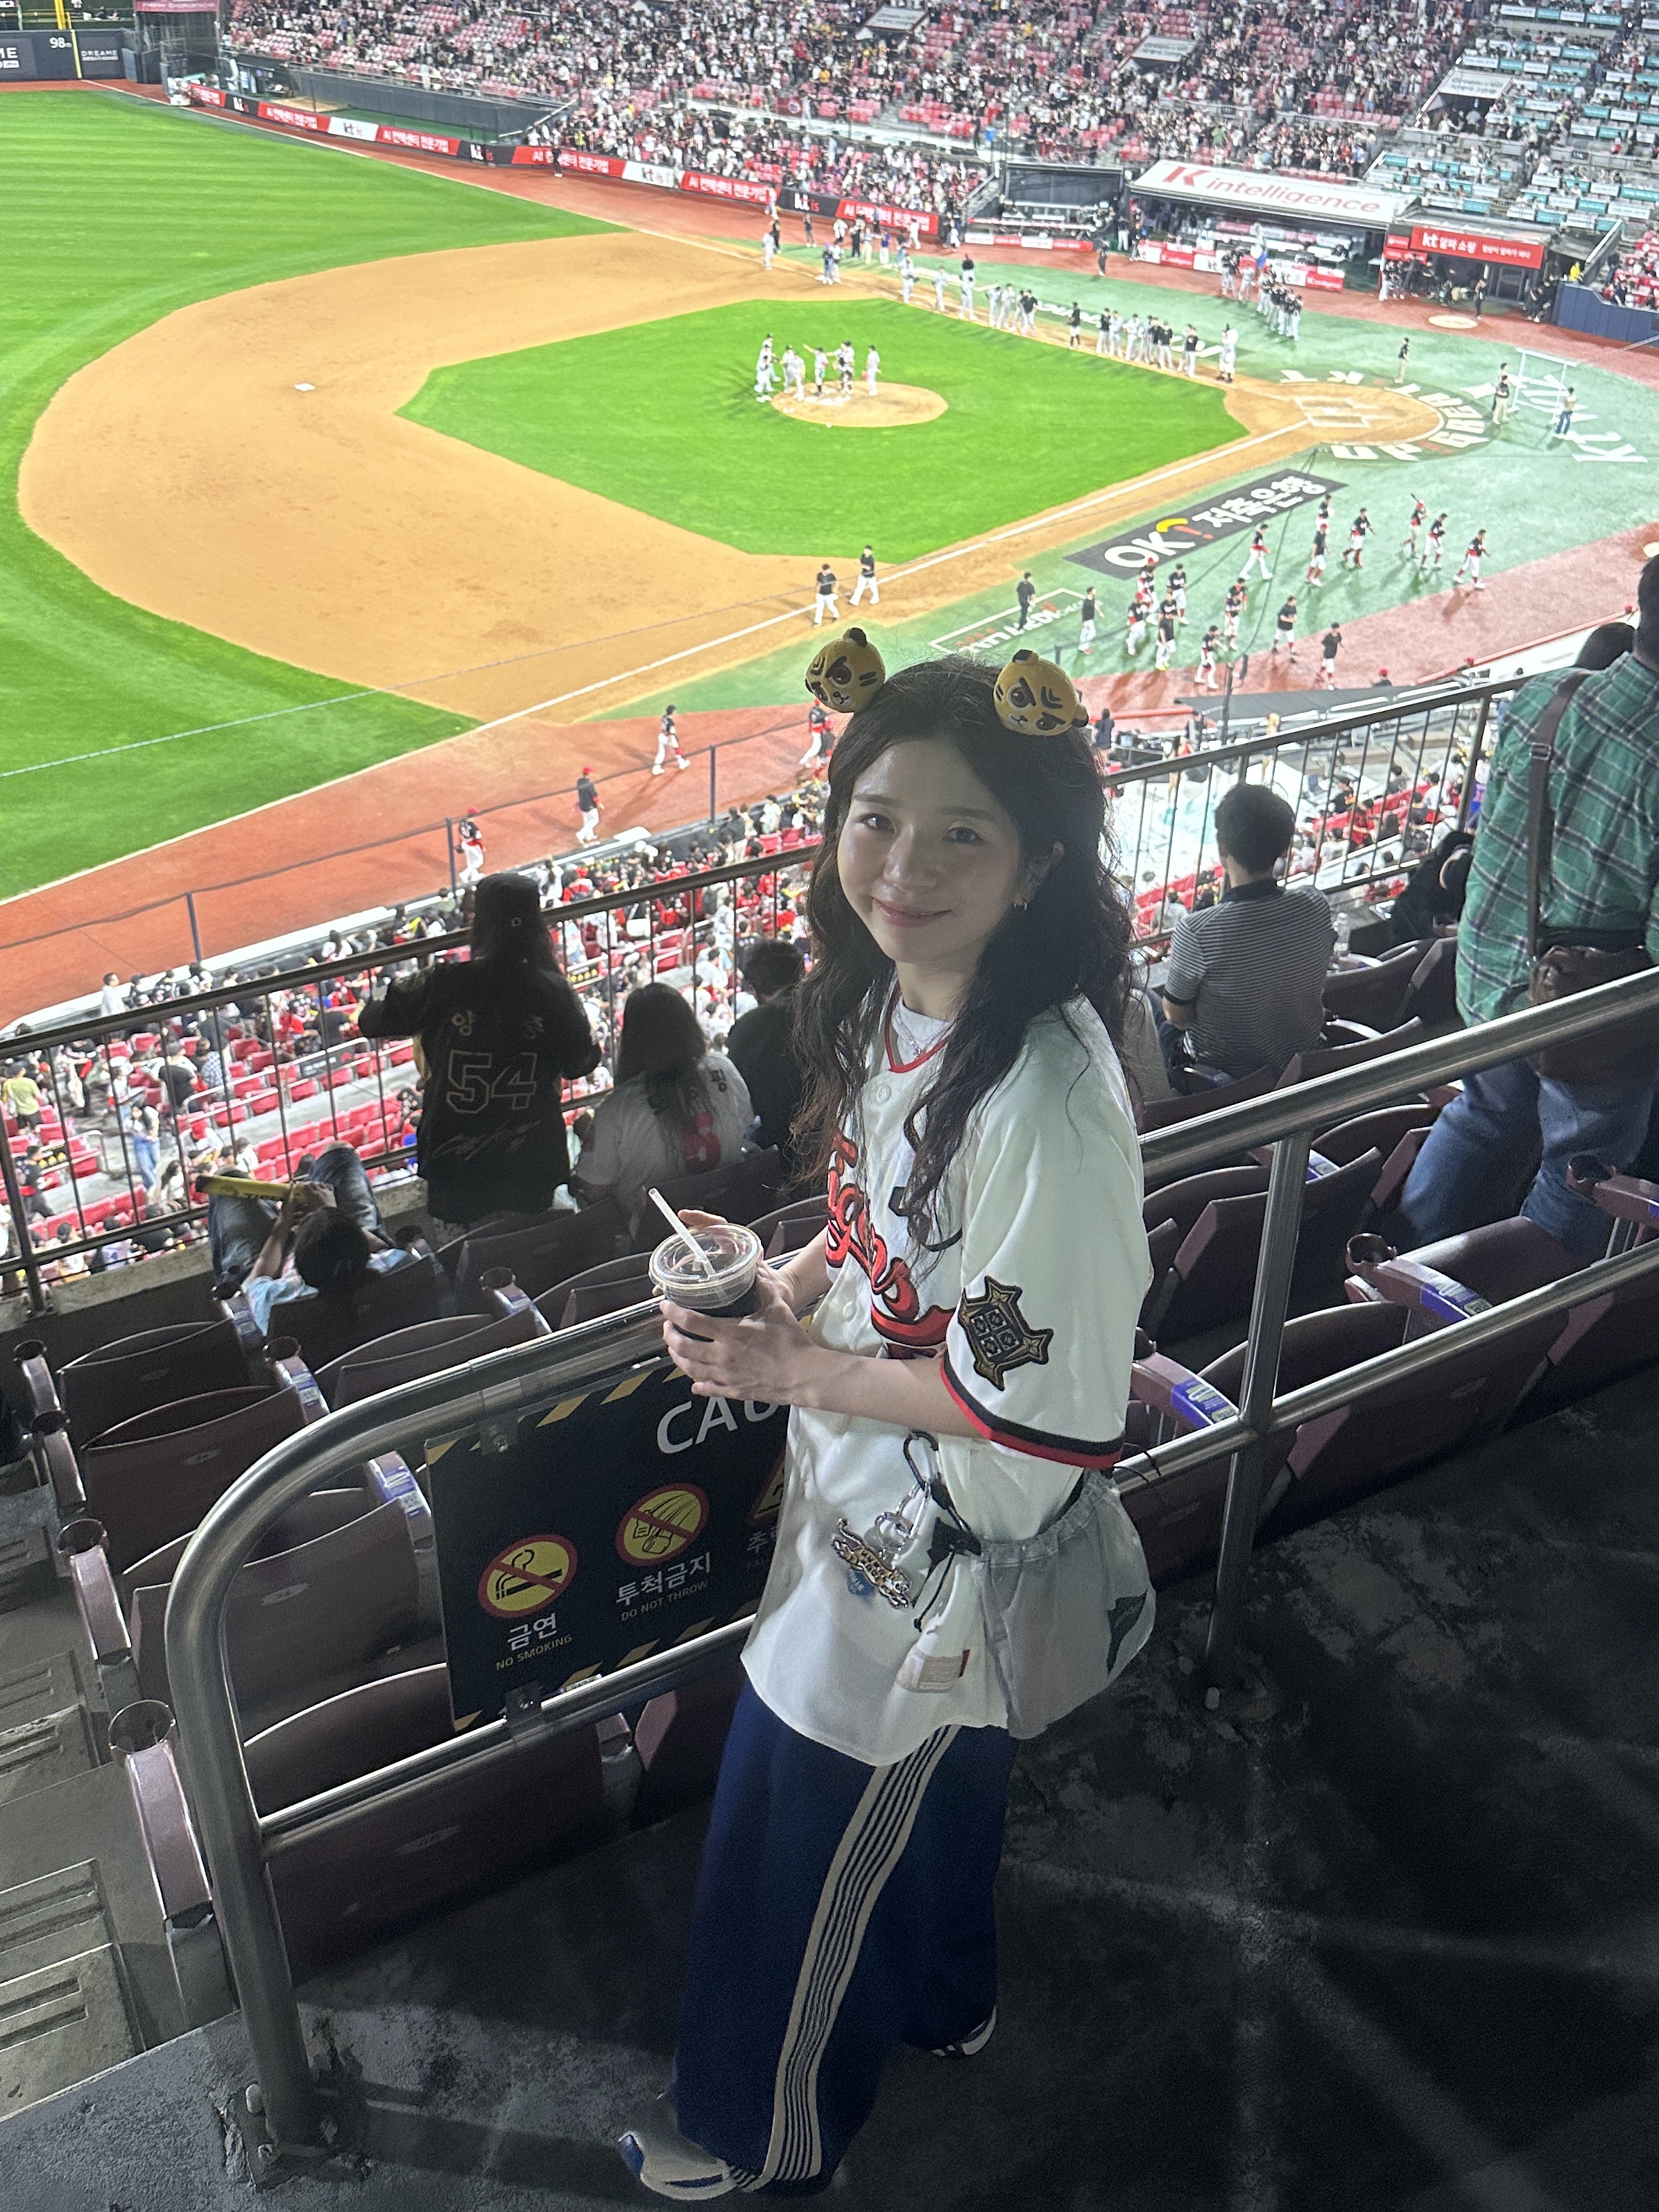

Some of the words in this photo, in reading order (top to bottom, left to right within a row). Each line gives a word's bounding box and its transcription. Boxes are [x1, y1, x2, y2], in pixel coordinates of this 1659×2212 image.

[1162, 166, 1214, 187] K
[1205, 176, 1381, 214] intelligence
[1192, 476, 1327, 530] 저축은행
[445, 1049, 539, 1115] 54
[616, 1552, 712, 1606] 투척금지
[620, 1608, 638, 1622] DO
[640, 1598, 667, 1617] NOT
[669, 1579, 709, 1604] THROW
[495, 1656, 515, 1672] NO
[516, 1635, 573, 1663] SMOKING
[507, 1613, 558, 1652] 금연
